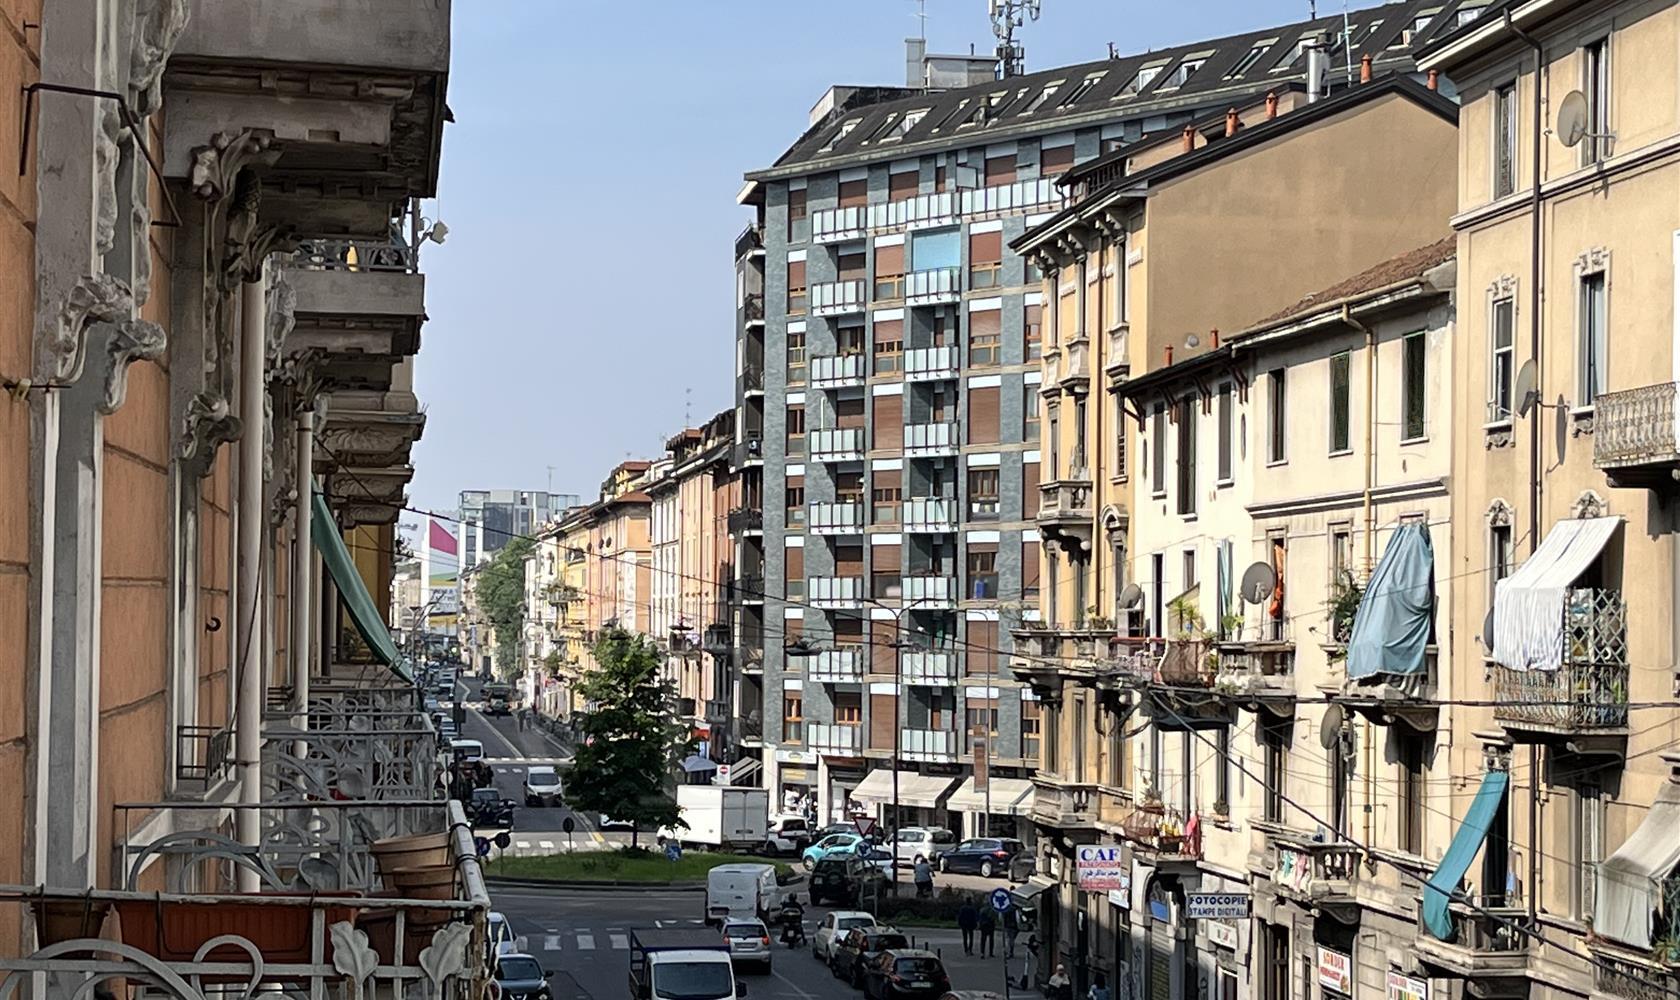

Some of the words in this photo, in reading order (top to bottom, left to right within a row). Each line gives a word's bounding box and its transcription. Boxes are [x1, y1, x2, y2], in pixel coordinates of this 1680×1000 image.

[1080, 848, 1120, 861] CAF
[1189, 896, 1247, 905] FOTOCOPIE
[1188, 907, 1216, 916] STAMPE
[1217, 907, 1247, 916] DIGITALI
